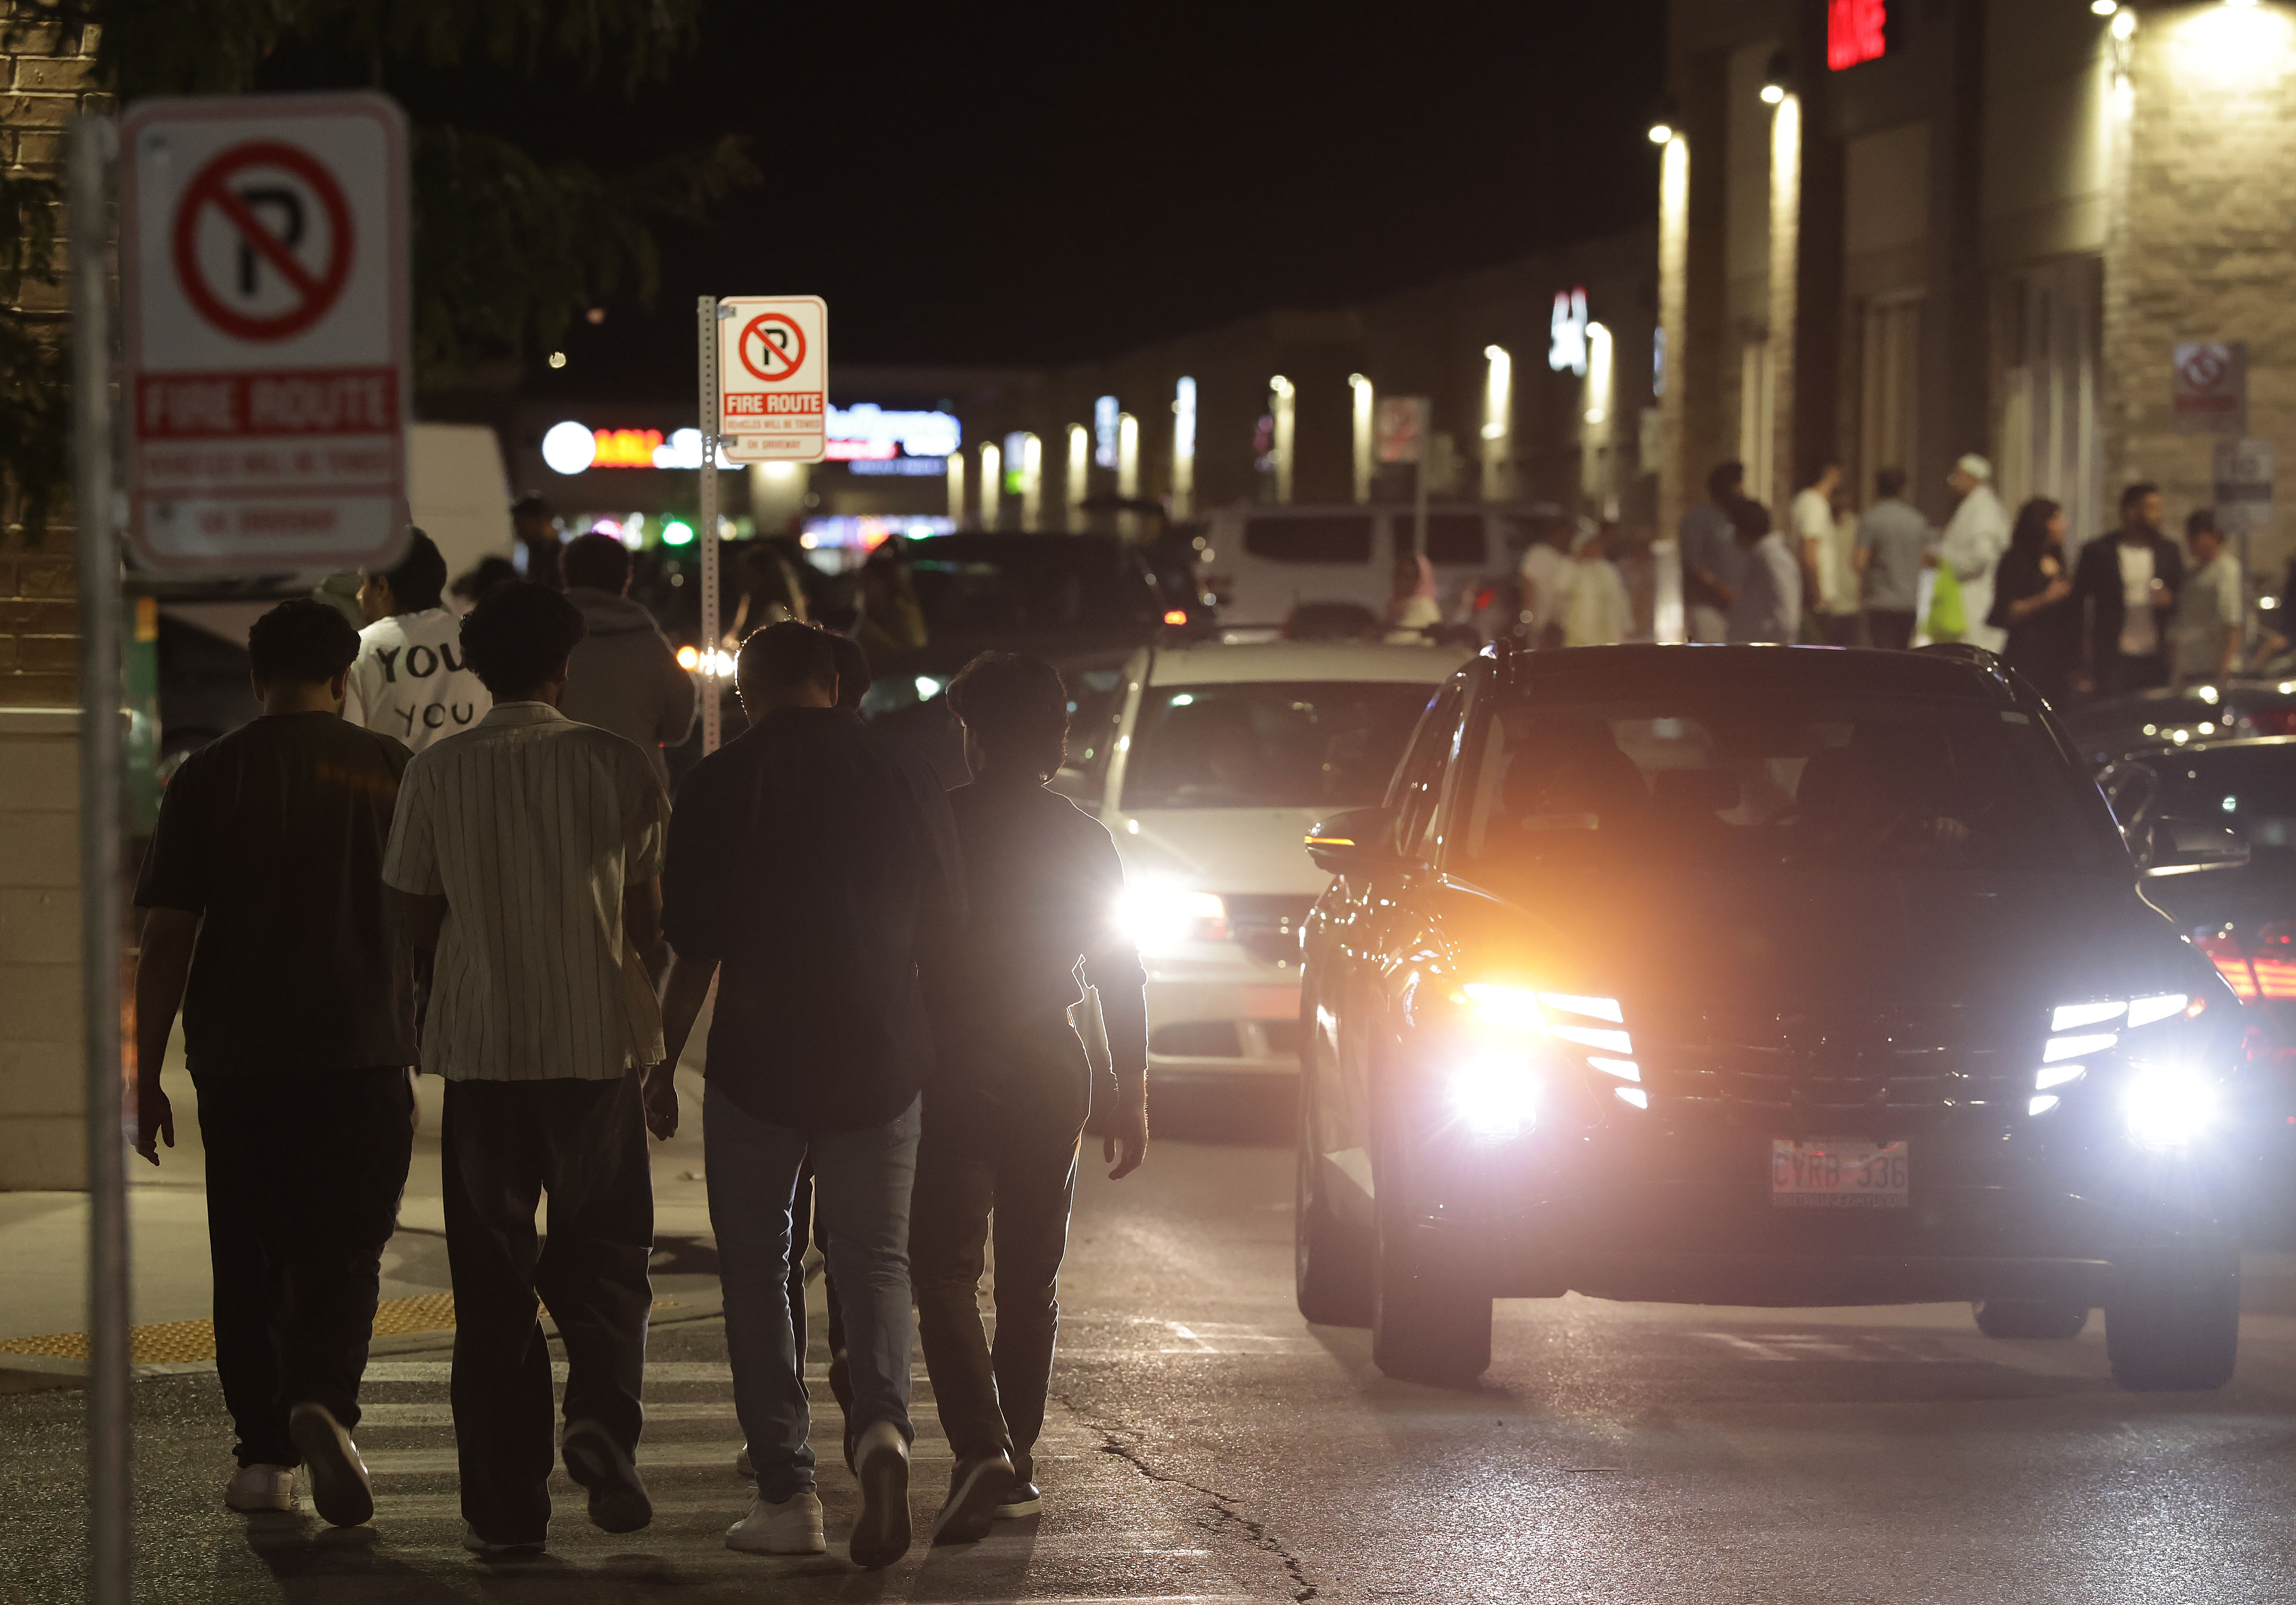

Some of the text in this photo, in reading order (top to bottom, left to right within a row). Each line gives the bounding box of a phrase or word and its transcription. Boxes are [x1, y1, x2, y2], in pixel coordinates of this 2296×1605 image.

[145, 378, 385, 432] FIRE ROUTE
[727, 394, 822, 414] FIRE ROUTE
[394, 702, 473, 738] YOU
[1858, 1154, 1905, 1189] 336
